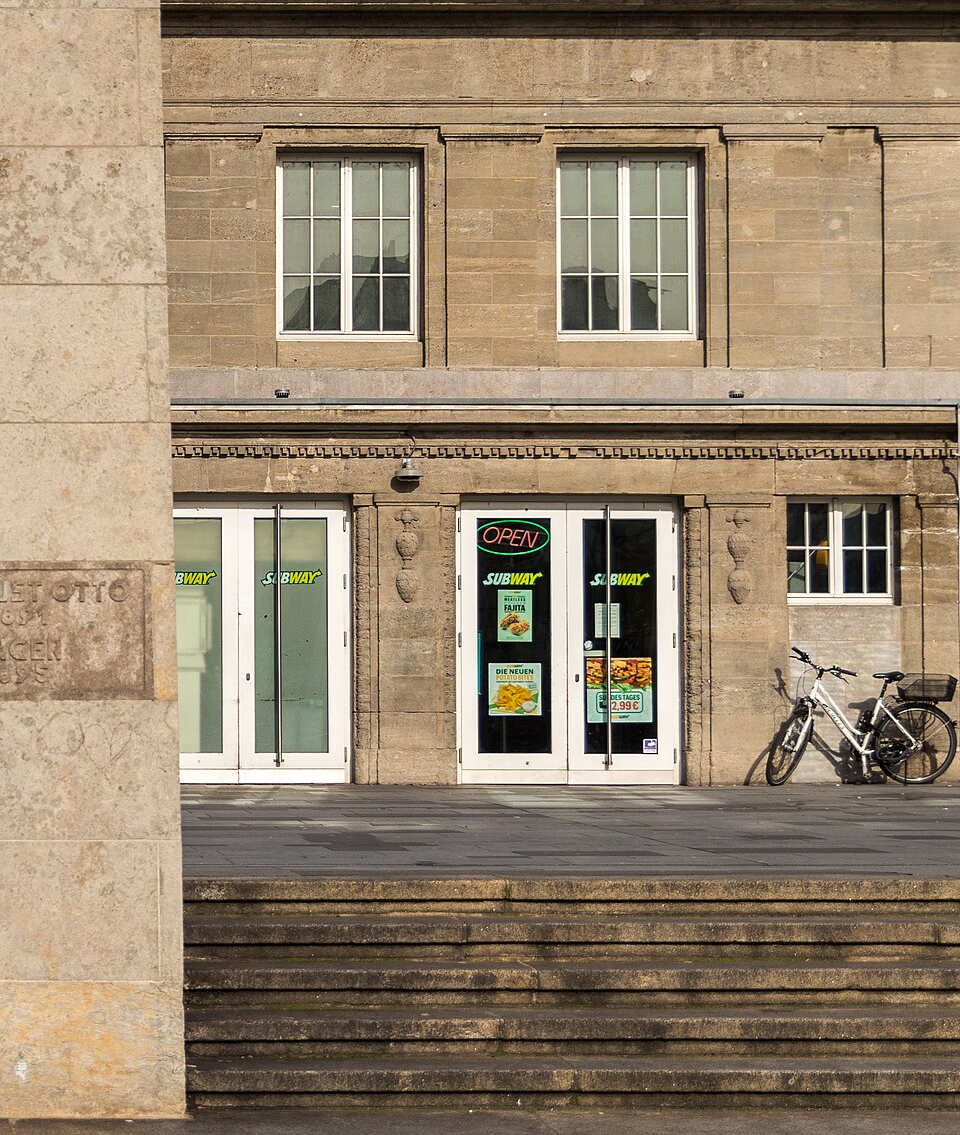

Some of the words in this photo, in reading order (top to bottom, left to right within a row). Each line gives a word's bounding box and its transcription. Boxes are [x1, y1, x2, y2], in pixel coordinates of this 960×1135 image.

[483, 526, 539, 548] OPEN
[174, 570, 217, 586] BWAY
[483, 572, 543, 586] SUBWAY
[51, 578, 131, 603] OTTO
